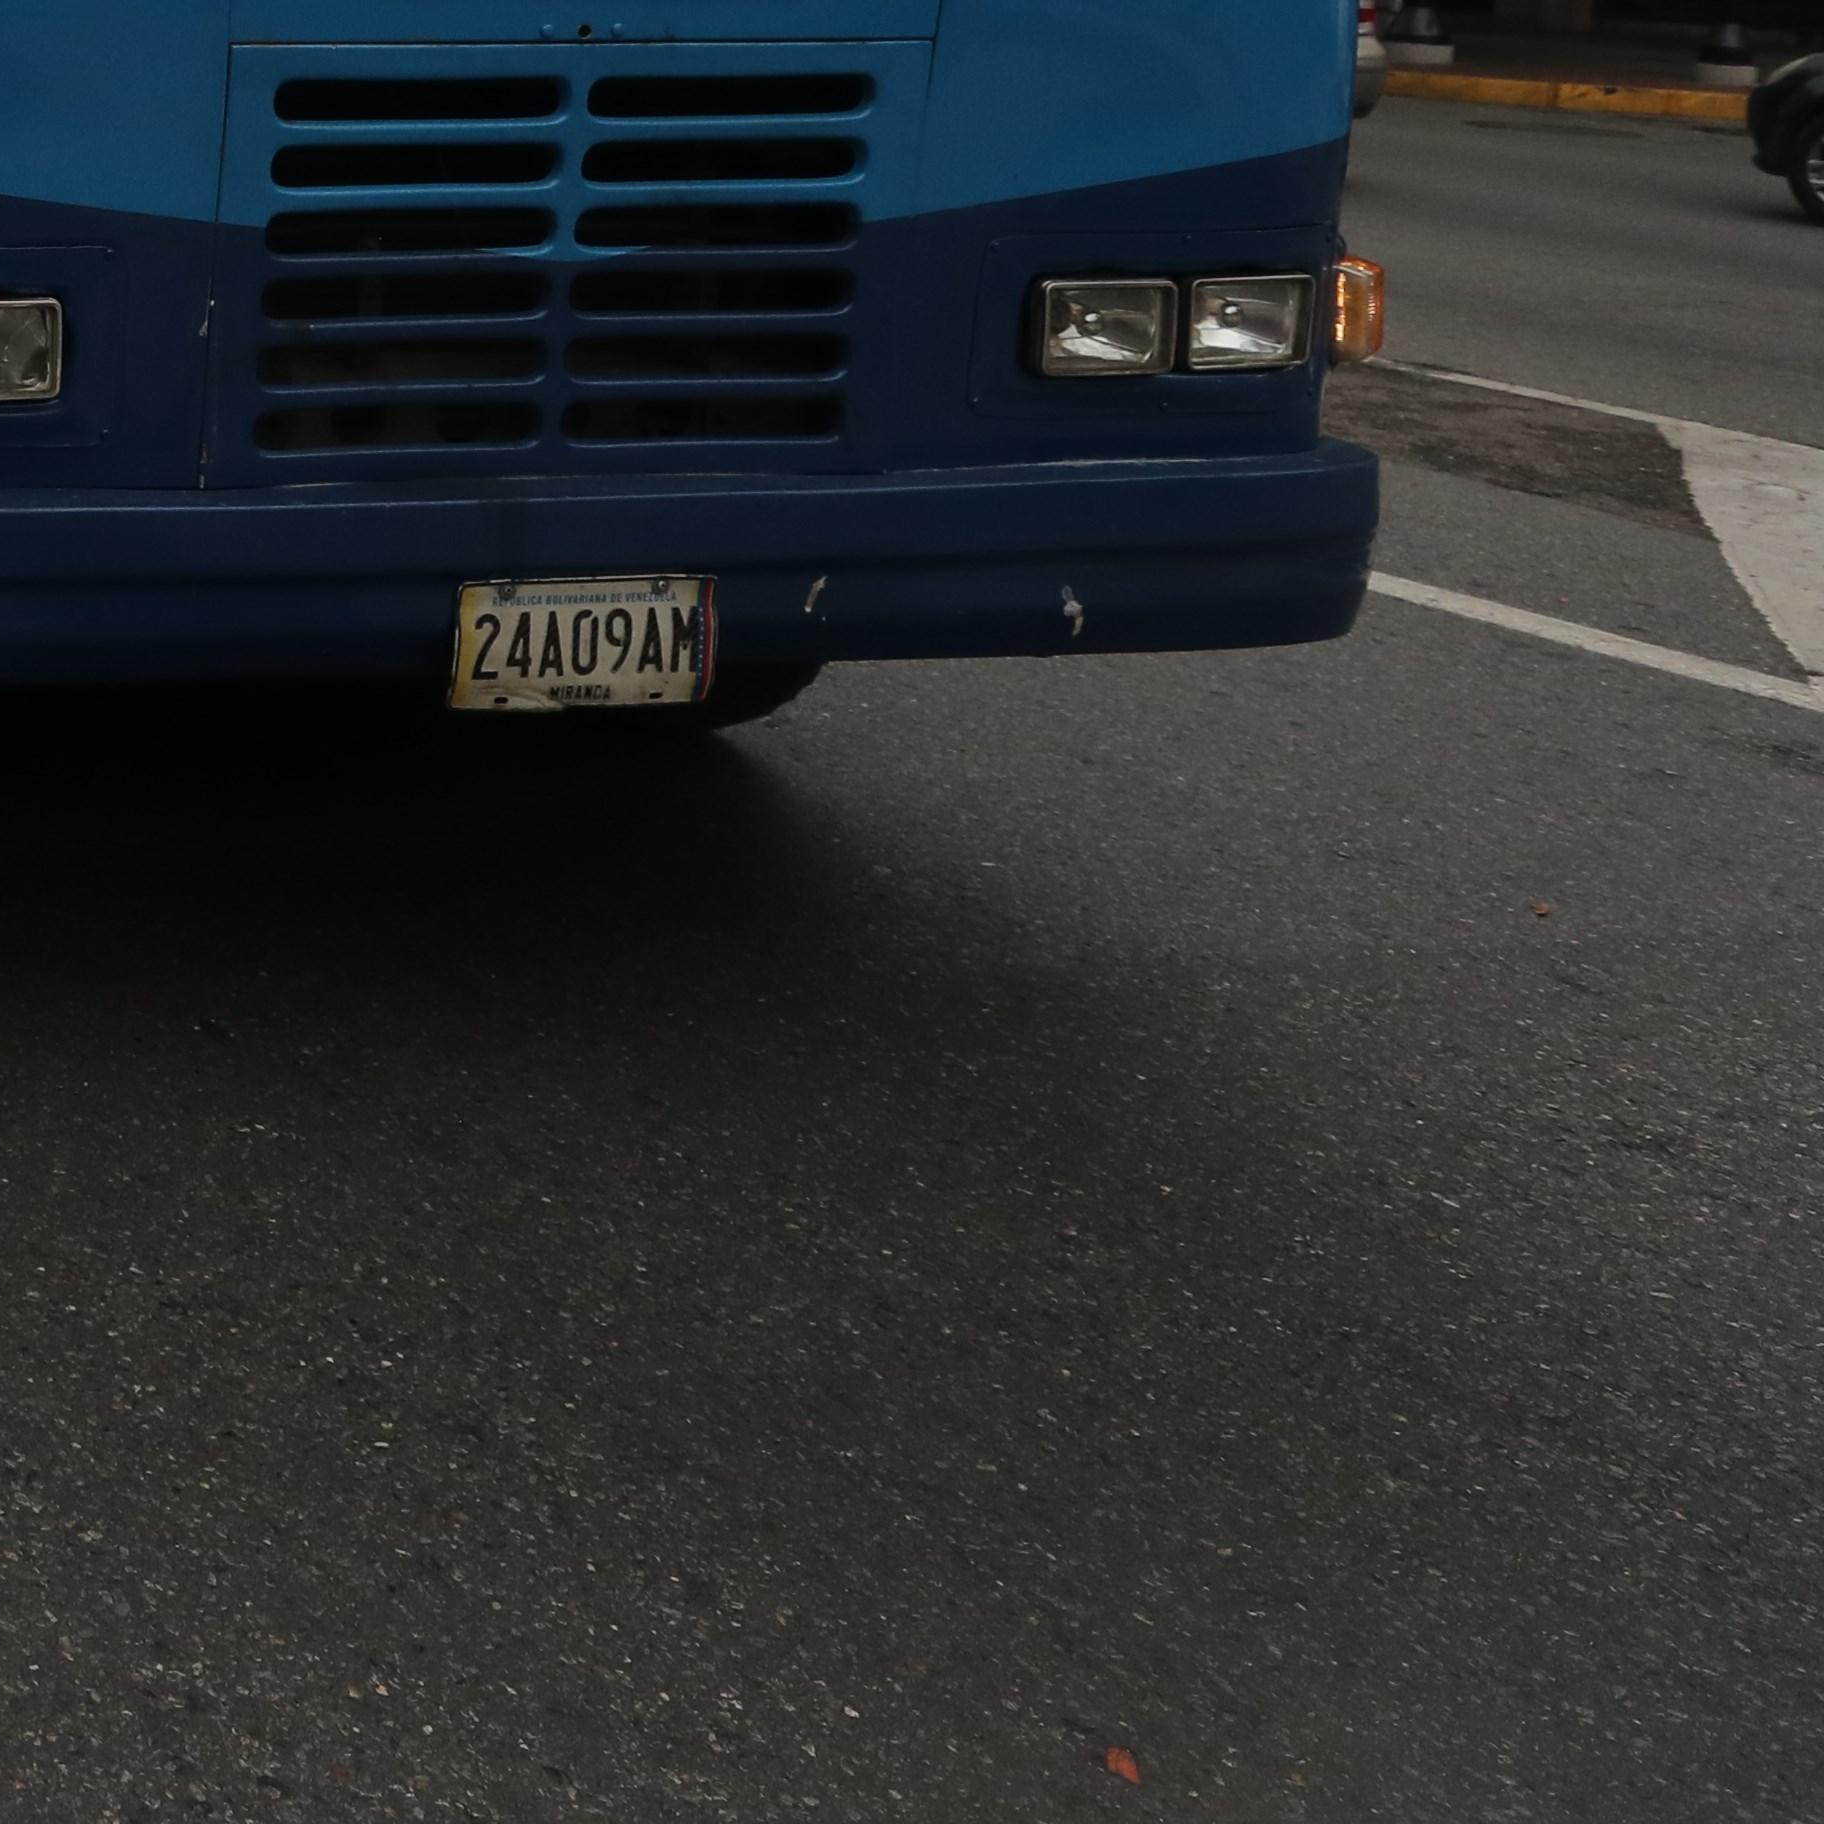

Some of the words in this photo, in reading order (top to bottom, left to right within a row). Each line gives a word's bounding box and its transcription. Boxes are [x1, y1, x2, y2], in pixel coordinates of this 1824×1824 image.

[610, 592, 623, 604] DE
[471, 607, 699, 680] 24A09AM
[549, 684, 612, 701] MIRANDA
